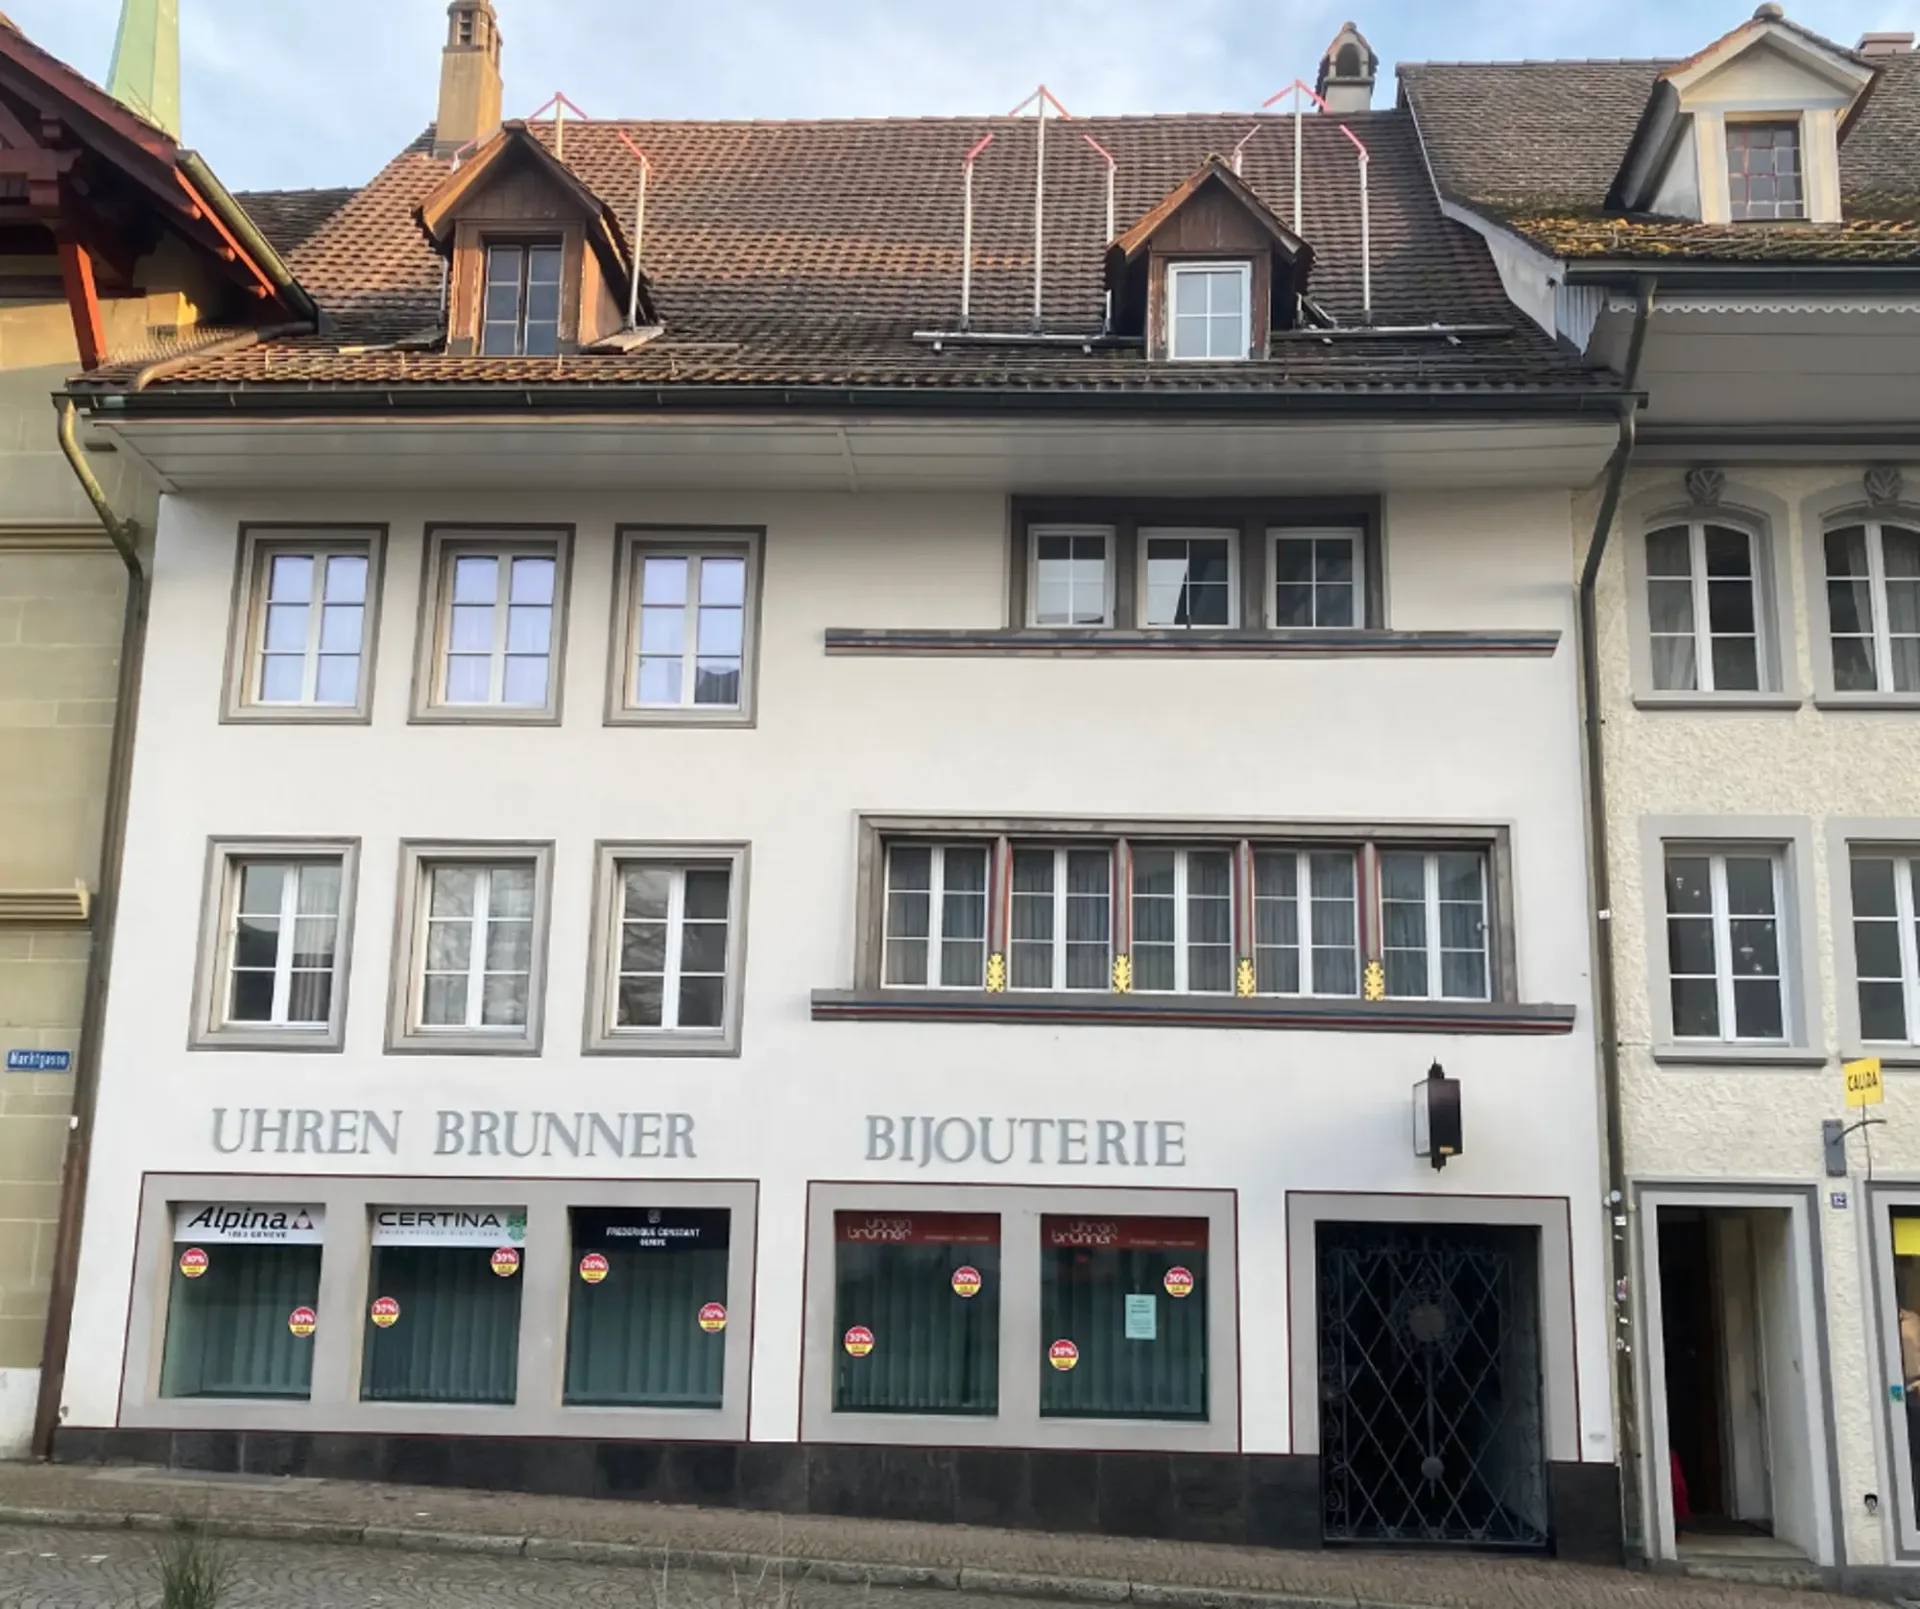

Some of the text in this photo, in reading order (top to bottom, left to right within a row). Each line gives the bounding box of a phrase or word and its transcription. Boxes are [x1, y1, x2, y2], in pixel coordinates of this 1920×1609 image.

[10, 1051, 66, 1068] Marktgasse
[1848, 1070, 1878, 1092] CALIDA
[212, 1107, 698, 1158] UHREN BRUNNER
[864, 1114, 1187, 1168] BIJOUTERIE
[187, 1205, 288, 1234] Alpina
[378, 1211, 501, 1228] CERTINA
